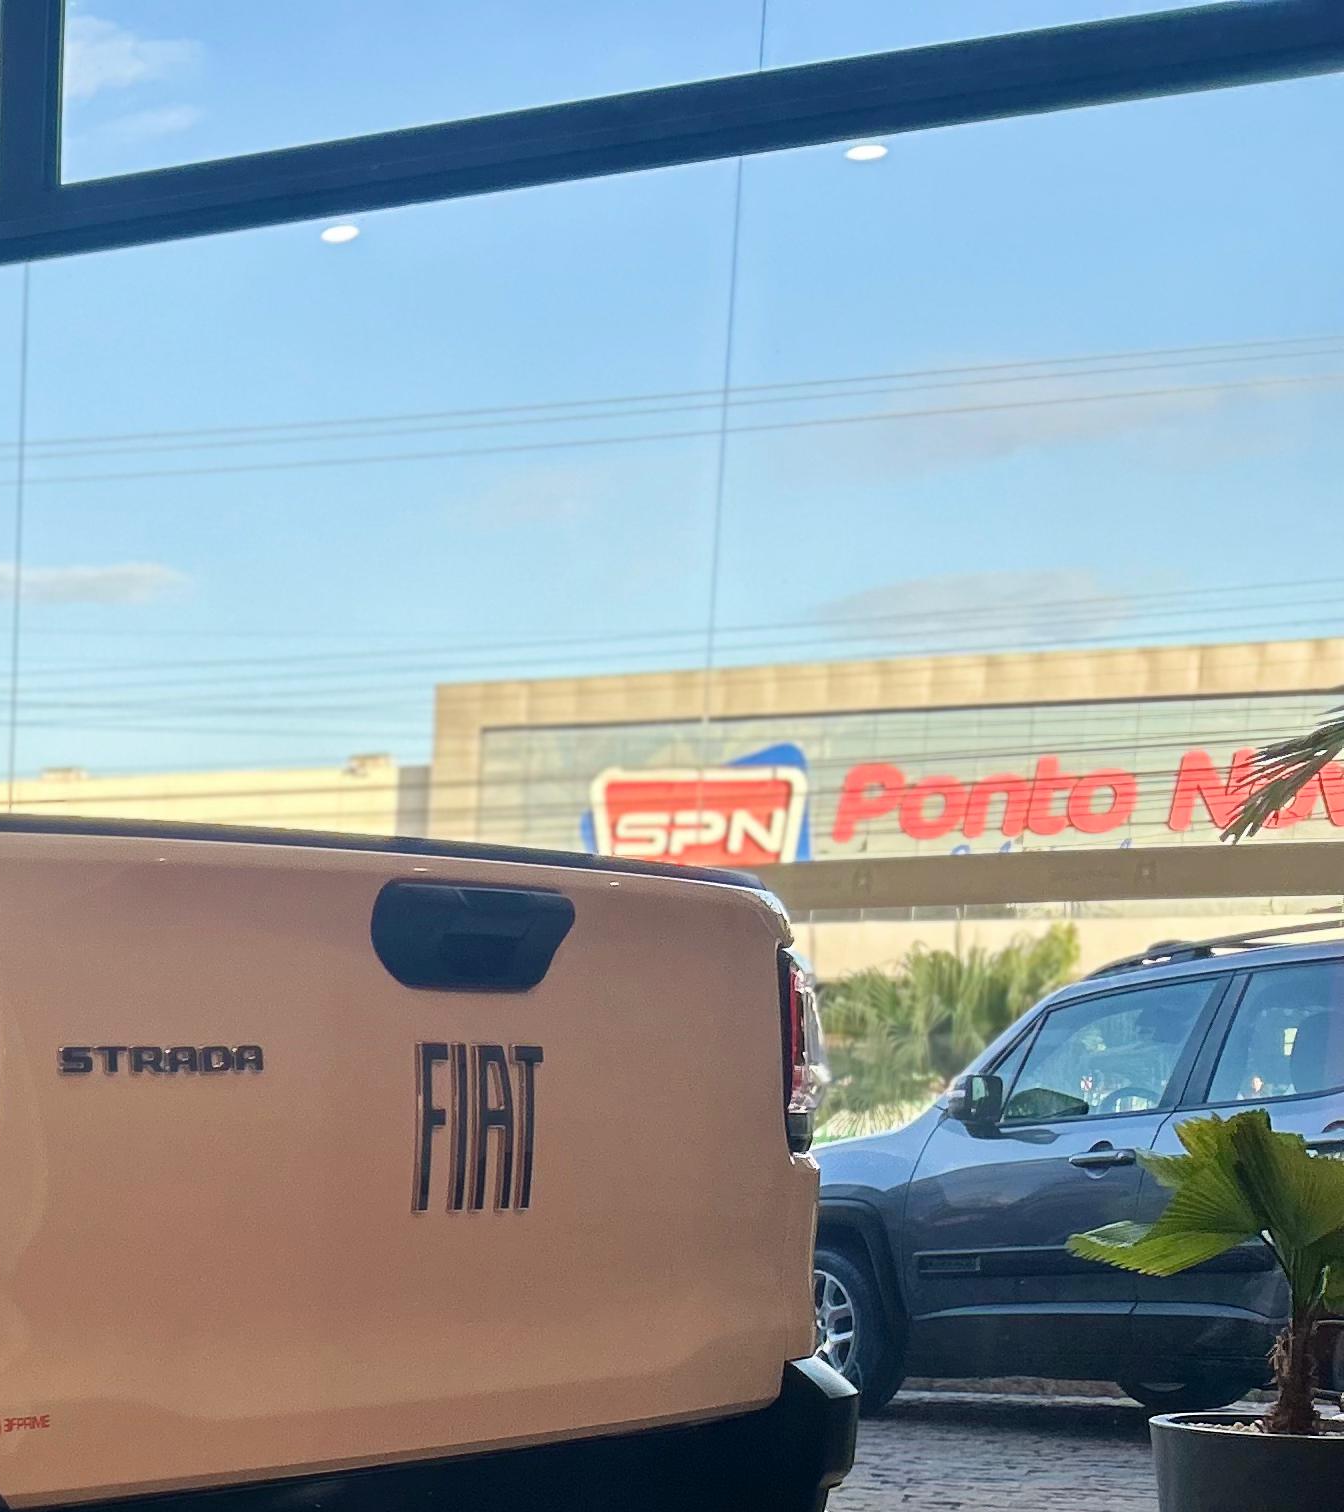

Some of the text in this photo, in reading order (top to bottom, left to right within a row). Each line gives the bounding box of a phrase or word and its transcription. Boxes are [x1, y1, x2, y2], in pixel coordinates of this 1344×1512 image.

[613, 808, 787, 856] SPN
[832, 755, 1137, 843] Ponto
[57, 1044, 264, 1076] STRADA
[410, 1041, 544, 1214] FIAT
